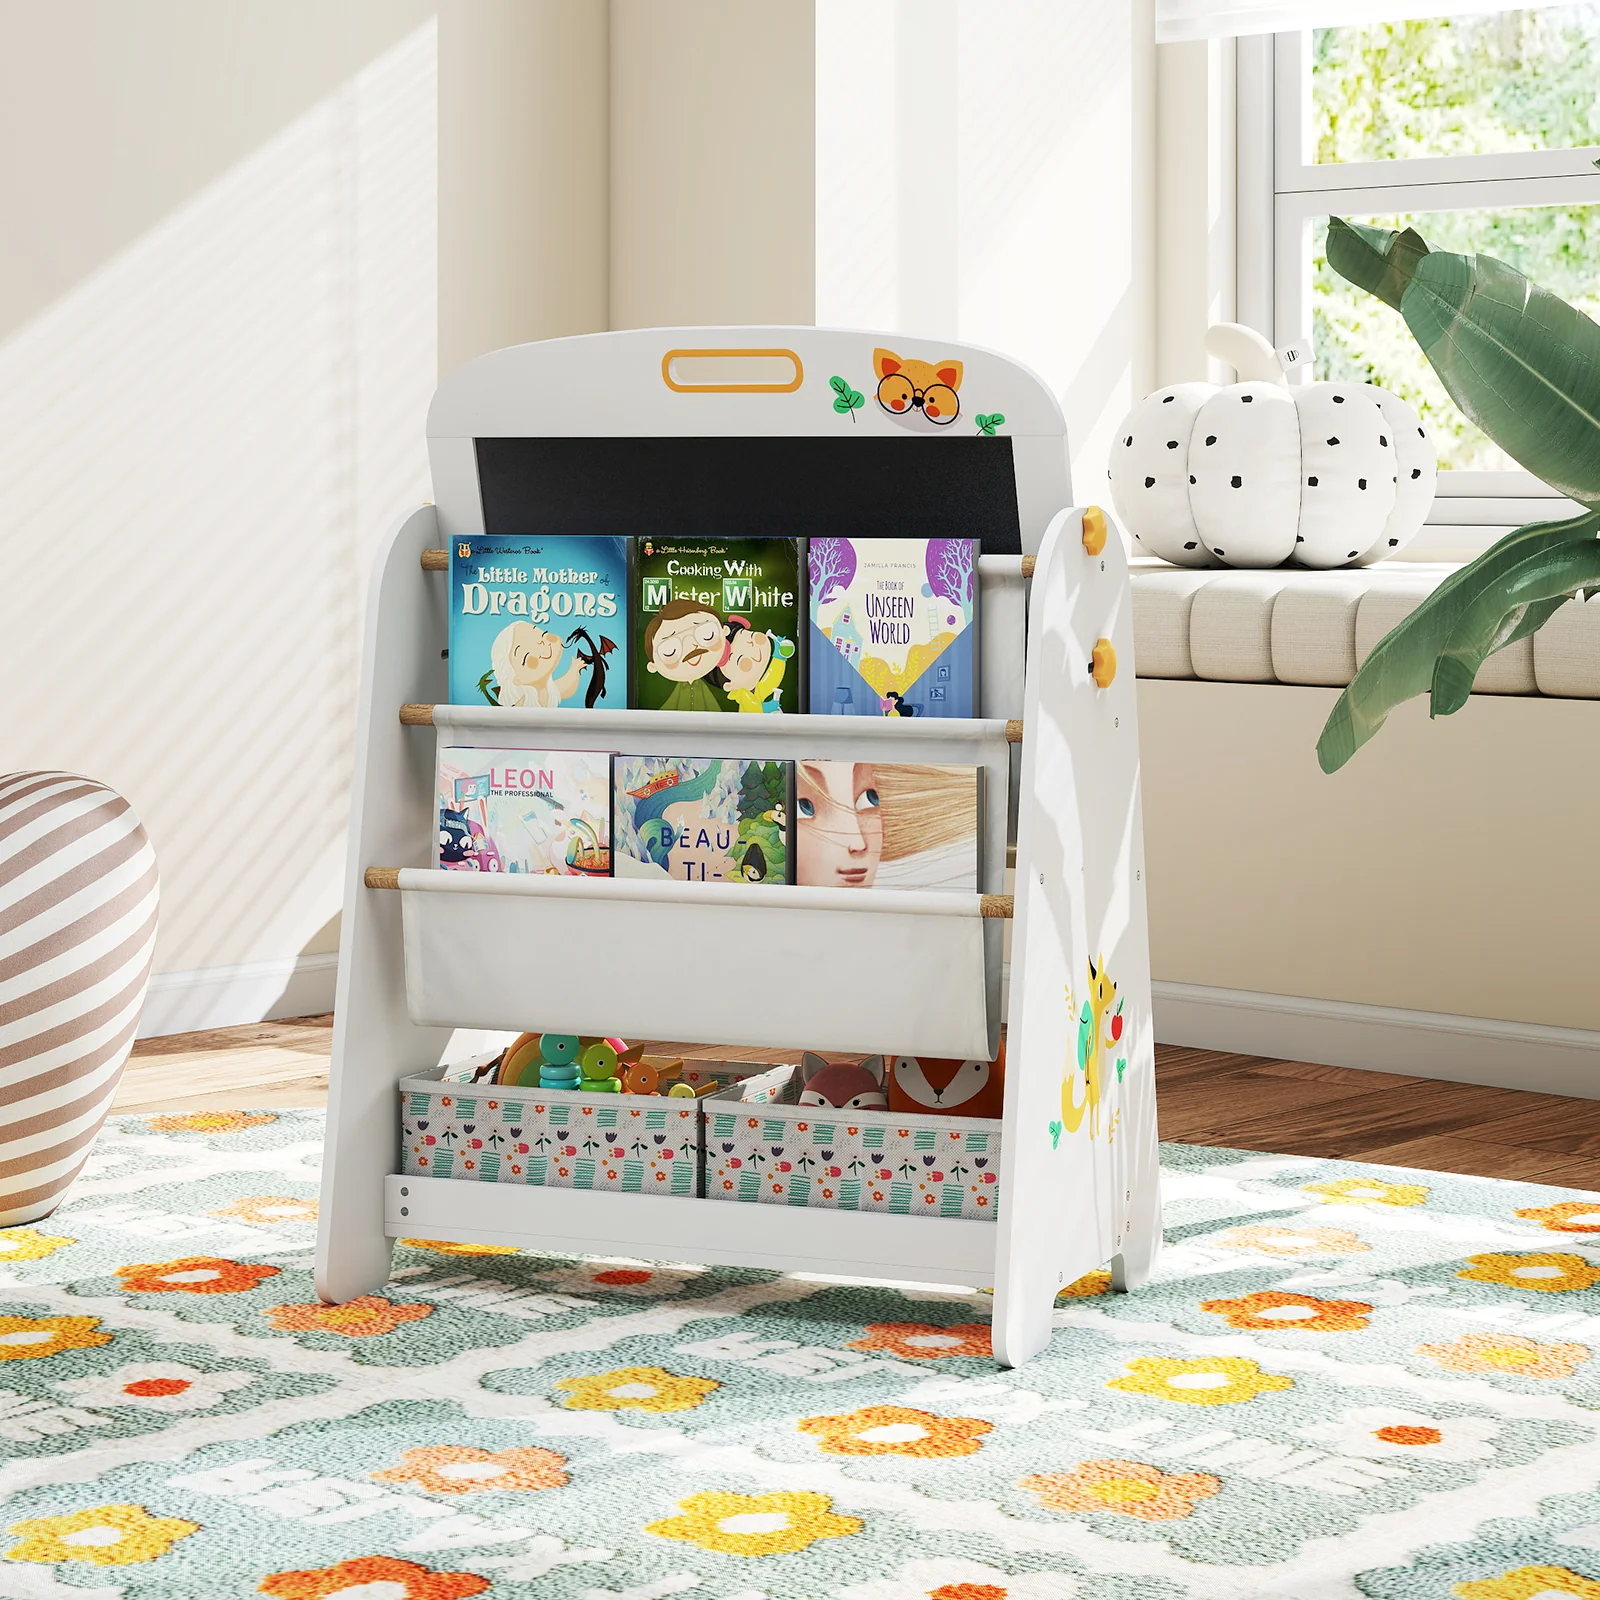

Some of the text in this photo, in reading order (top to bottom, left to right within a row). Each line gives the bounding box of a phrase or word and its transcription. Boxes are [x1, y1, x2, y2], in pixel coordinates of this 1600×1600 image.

[476, 546, 494, 555] Little
[495, 546, 522, 555] Westeros
[522, 545, 542, 555] Book
[661, 545, 678, 555] Little
[708, 545, 726, 555] Book
[461, 563, 610, 587] The Little Mother of
[667, 559, 763, 579] Cooking With
[724, 585, 794, 608] White
[876, 580, 905, 591] THE BOOK OF
[462, 583, 618, 624] Dragons
[865, 593, 914, 619] UNSEEN
[869, 618, 911, 645] WORLD
[489, 768, 554, 790] LEON
[491, 789, 554, 798] THE PROFESSIONAL
